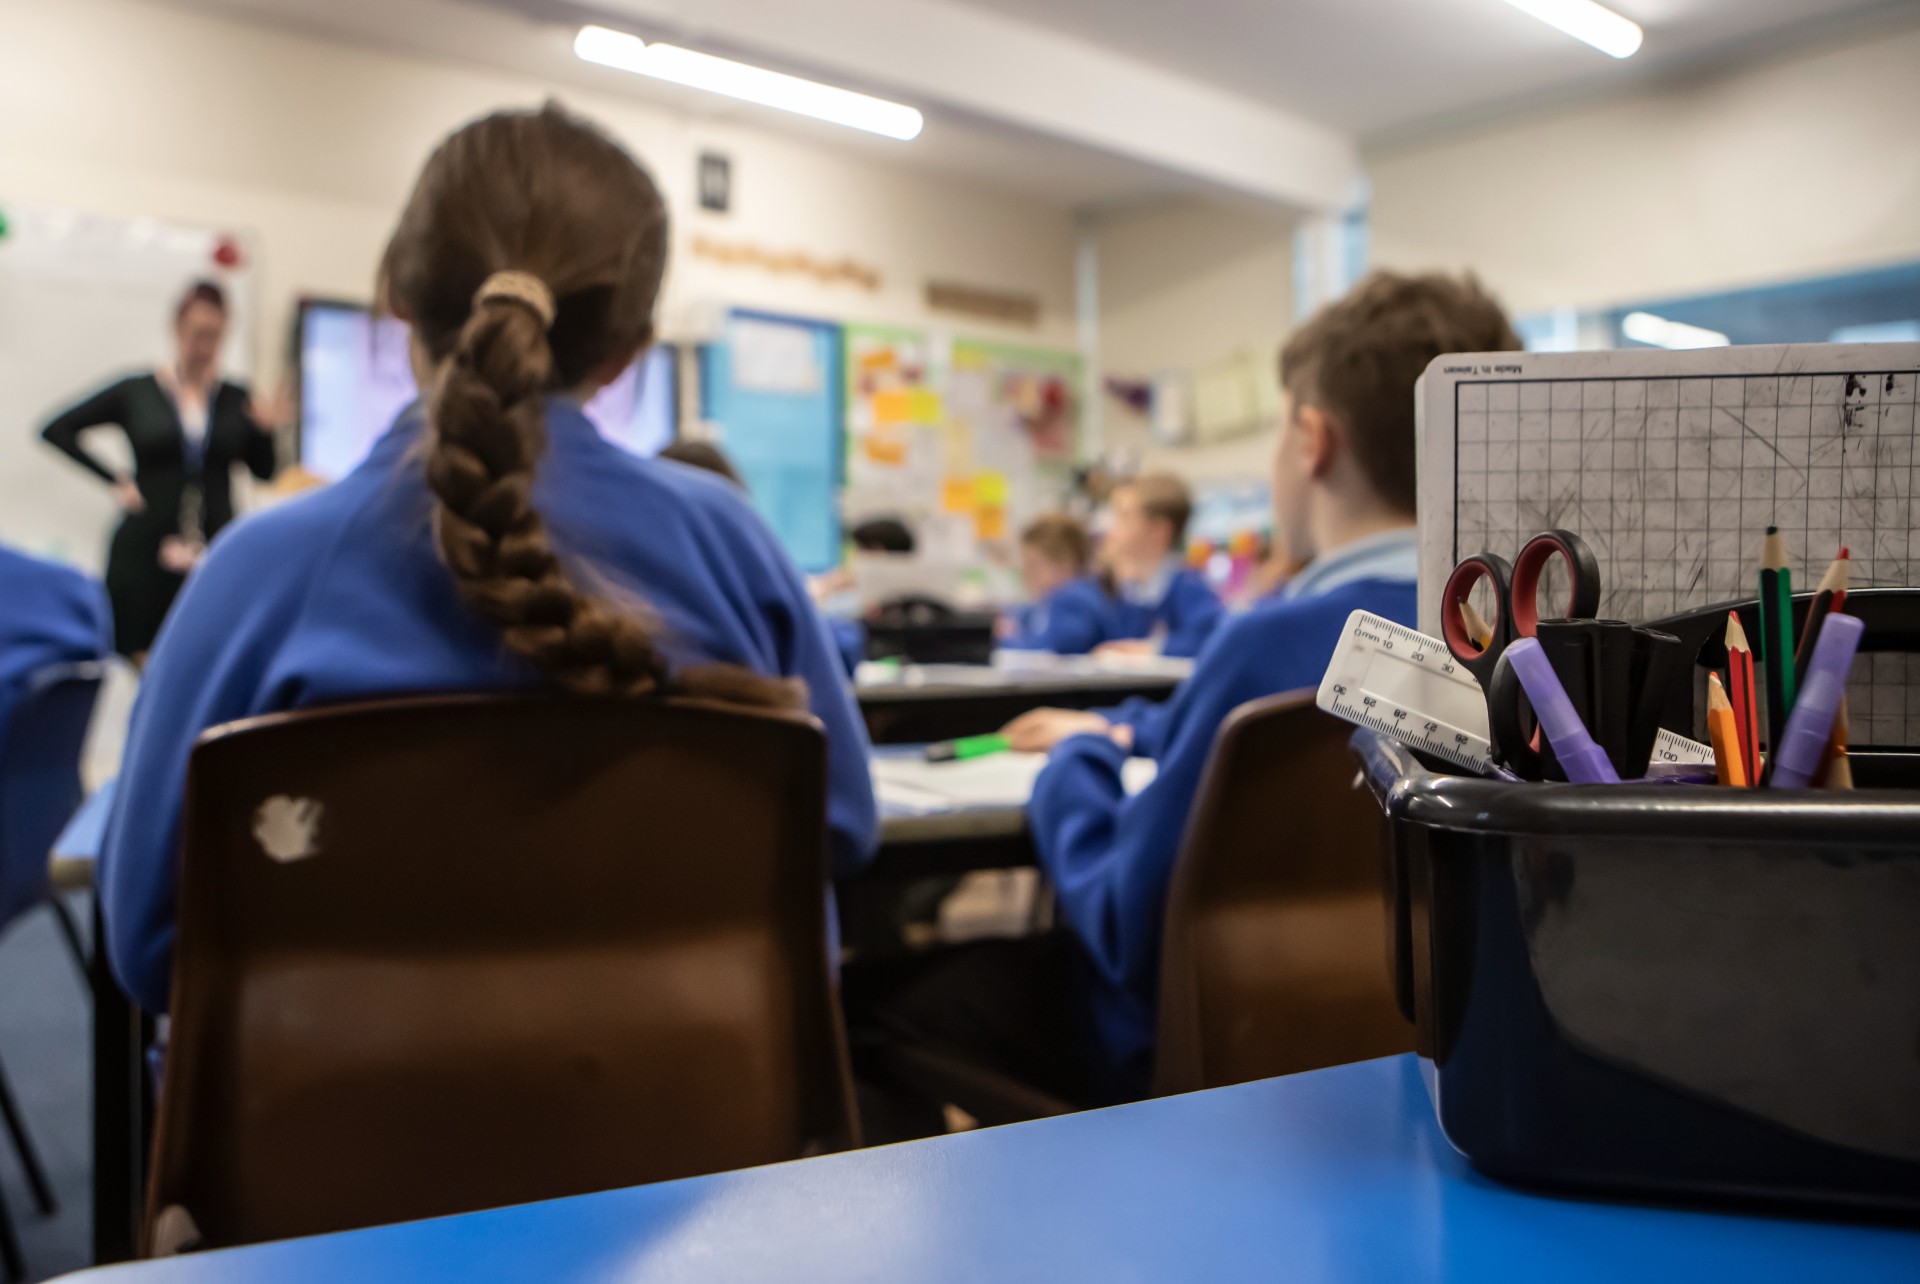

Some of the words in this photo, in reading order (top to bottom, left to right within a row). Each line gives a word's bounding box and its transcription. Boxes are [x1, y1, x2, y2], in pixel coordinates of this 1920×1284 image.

[1443, 366, 1479, 375] Taiwan
[1495, 365, 1522, 374] Made
[1333, 684, 1347, 695] 30
[1363, 696, 1376, 708] 29
[1382, 640, 1393, 649] 10
[1411, 652, 1424, 662] 20
[1442, 664, 1454, 674] 30
[1659, 749, 1678, 762] 100
[1393, 709, 1407, 720] 28
[1424, 721, 1438, 732] 27
[1455, 733, 1469, 745] 26
